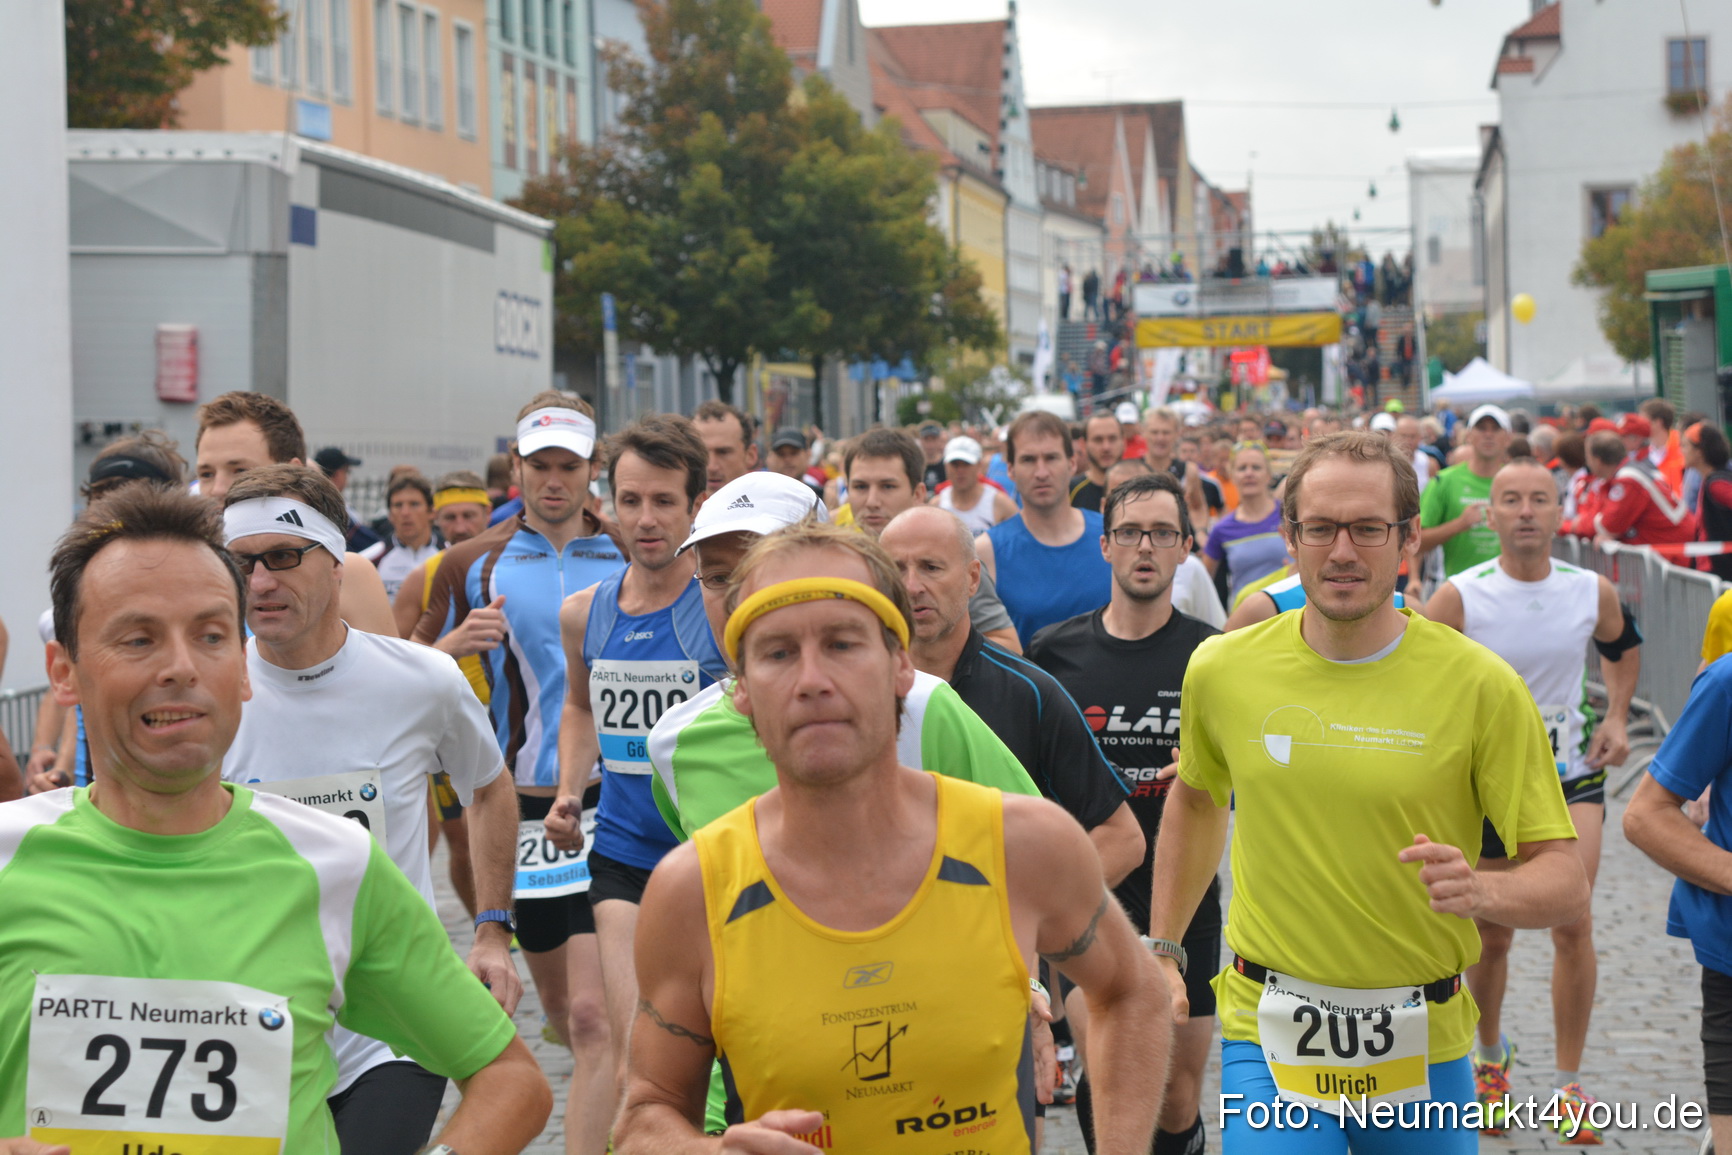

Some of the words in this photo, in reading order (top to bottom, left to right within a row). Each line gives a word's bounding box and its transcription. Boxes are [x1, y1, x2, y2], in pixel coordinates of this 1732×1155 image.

[1202, 322, 1272, 341] START
[592, 671, 622, 683] PARTL
[624, 672, 677, 683] Neumarkt
[1330, 723, 1364, 734] Kliniken
[1366, 726, 1380, 734] des
[1103, 737, 1118, 745] TO
[1120, 737, 1153, 745] YOUR
[1353, 734, 1395, 745] Neumarkt
[626, 741, 649, 758] Gö
[38, 997, 123, 1020] PARTL
[130, 1002, 248, 1026] Neumarkt
[1293, 1004, 1395, 1059] 203
[81, 1033, 238, 1122] 273
[1315, 1073, 1377, 1095] Ulrich
